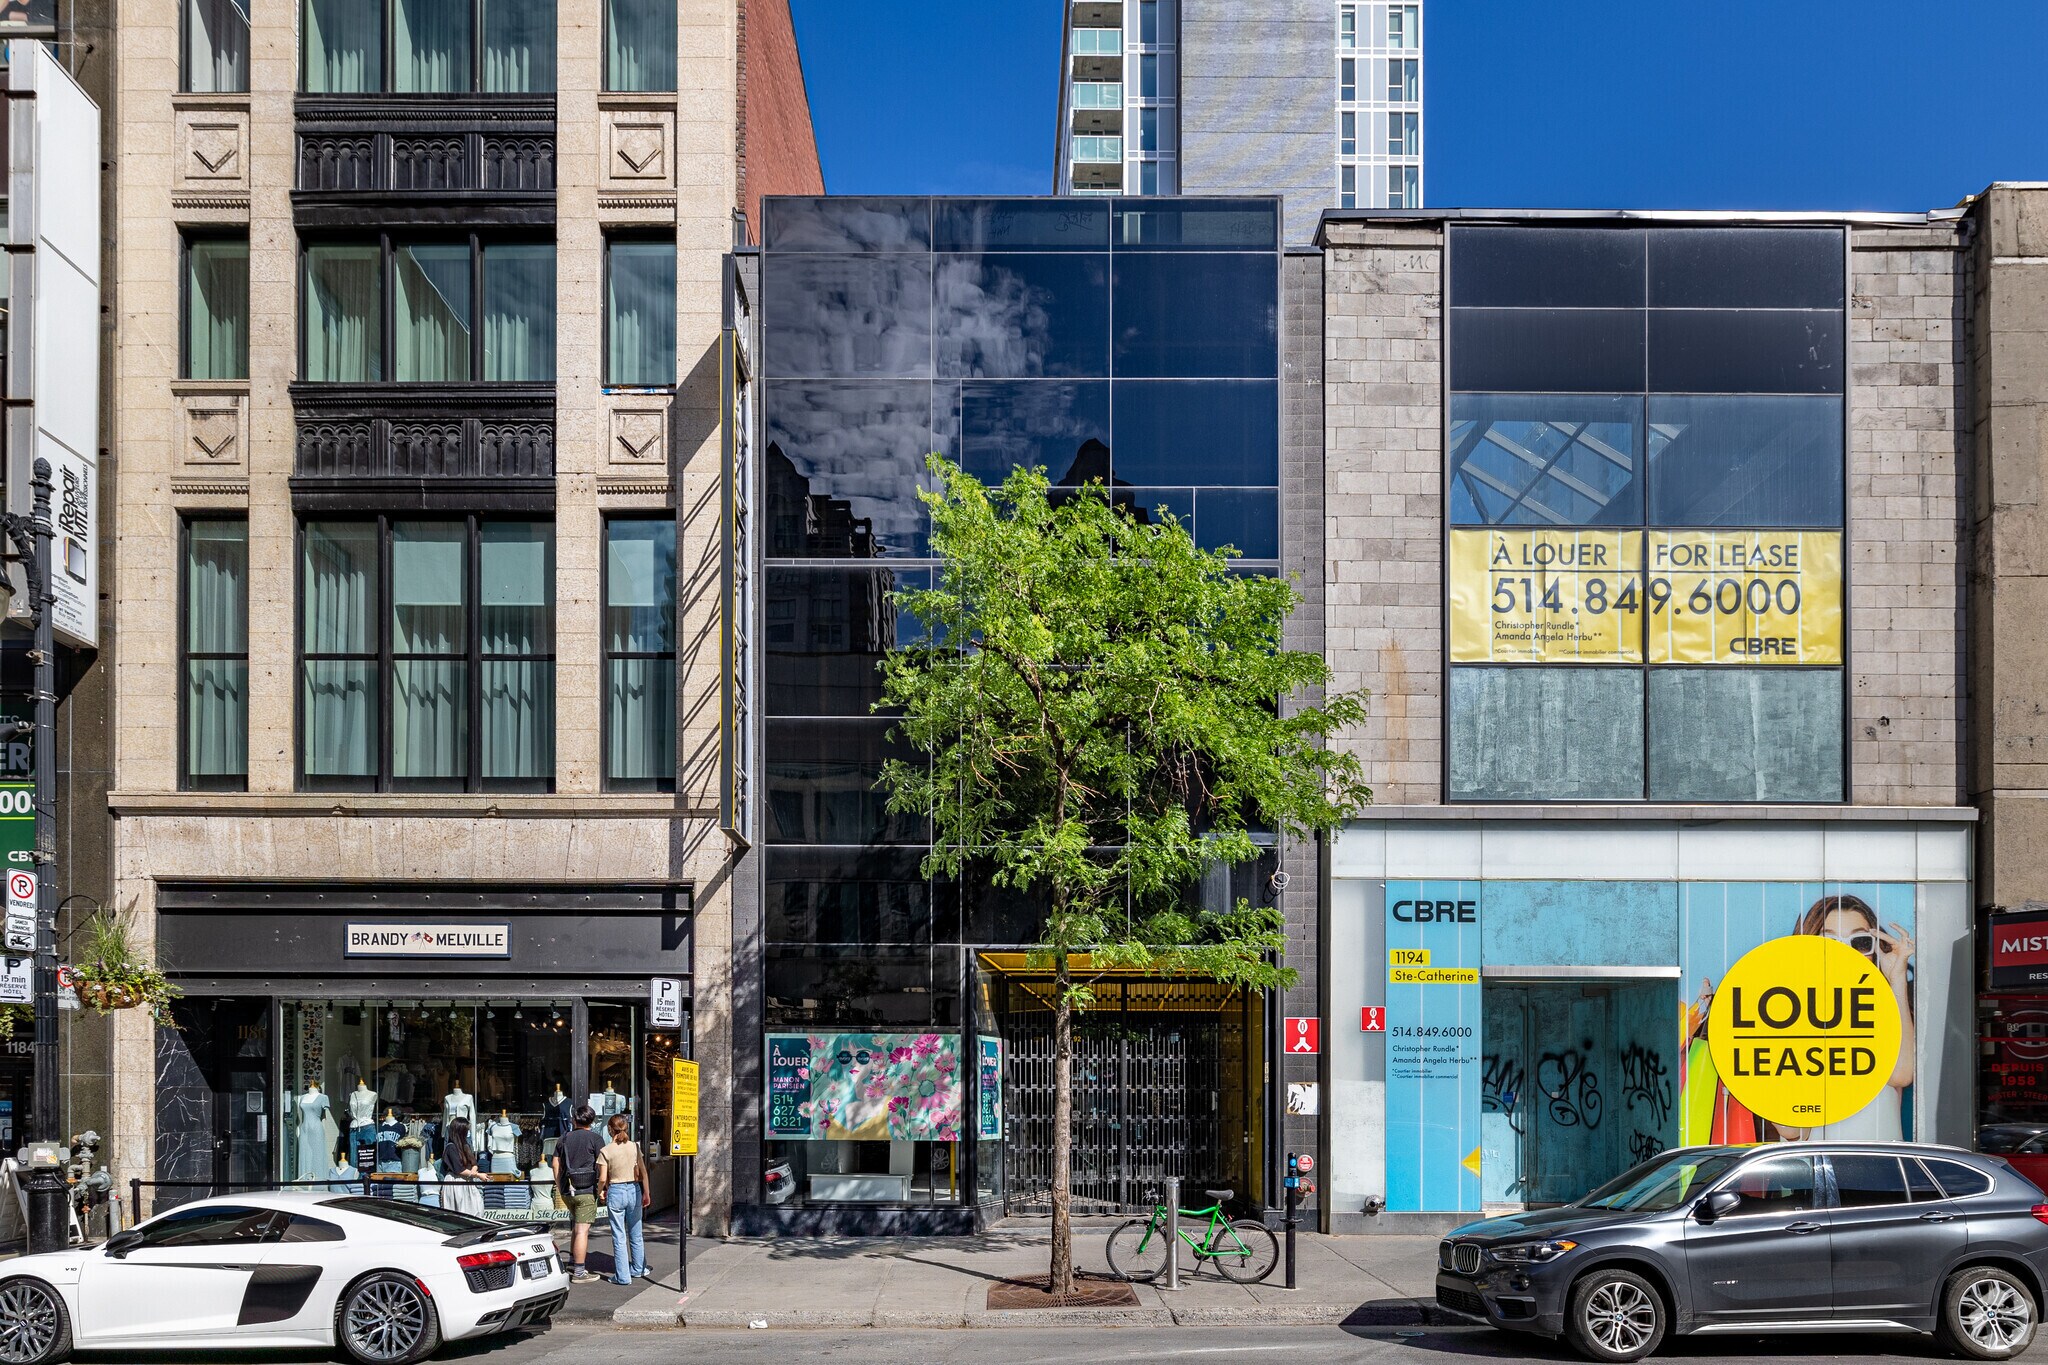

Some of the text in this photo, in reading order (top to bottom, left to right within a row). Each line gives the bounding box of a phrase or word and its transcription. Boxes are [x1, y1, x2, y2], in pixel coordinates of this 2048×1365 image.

[58, 464, 78, 535] iRepair
[73, 509, 88, 543] MTL
[1493, 537, 1607, 566] À LOUER
[1657, 544, 1797, 567] FOR LEASE
[1491, 577, 1801, 615] 514.849.6000
[1494, 621, 1544, 631] Christopher
[1494, 632, 1531, 641] Amanda
[1533, 632, 1564, 643] Angela
[1729, 637, 1797, 656] CBRE
[0, 790, 36, 814] 00
[9, 899, 35, 909] VENDREDI
[1392, 900, 1476, 923] CBRE
[351, 932, 504, 946] BRANDY MELVILLE
[1395, 951, 1424, 964] 1194
[1, 975, 26, 983] 15 min
[1395, 970, 1474, 982] Ste-Catherine
[657, 998, 664, 1006] 15
[1732, 973, 1875, 1029] LOUÉ
[1392, 1026, 1472, 1038] 514.849.6000
[5, 1041, 35, 1054] 1184
[773, 1044, 781, 1057] À
[1392, 1045, 1431, 1053] Christopher
[773, 1057, 809, 1067] LOUER
[982, 1056, 997, 1067] LOUER
[1423, 1057, 1448, 1065] Angela
[1733, 1047, 1876, 1077] LEASED
[1991, 1063, 2044, 1072] DEPUIS
[2001, 1075, 2036, 1086] 1958
[773, 1094, 794, 1105] 514
[773, 1105, 795, 1116] 627
[1792, 1105, 1822, 1113] CBRE
[773, 1116, 802, 1127] 0321
